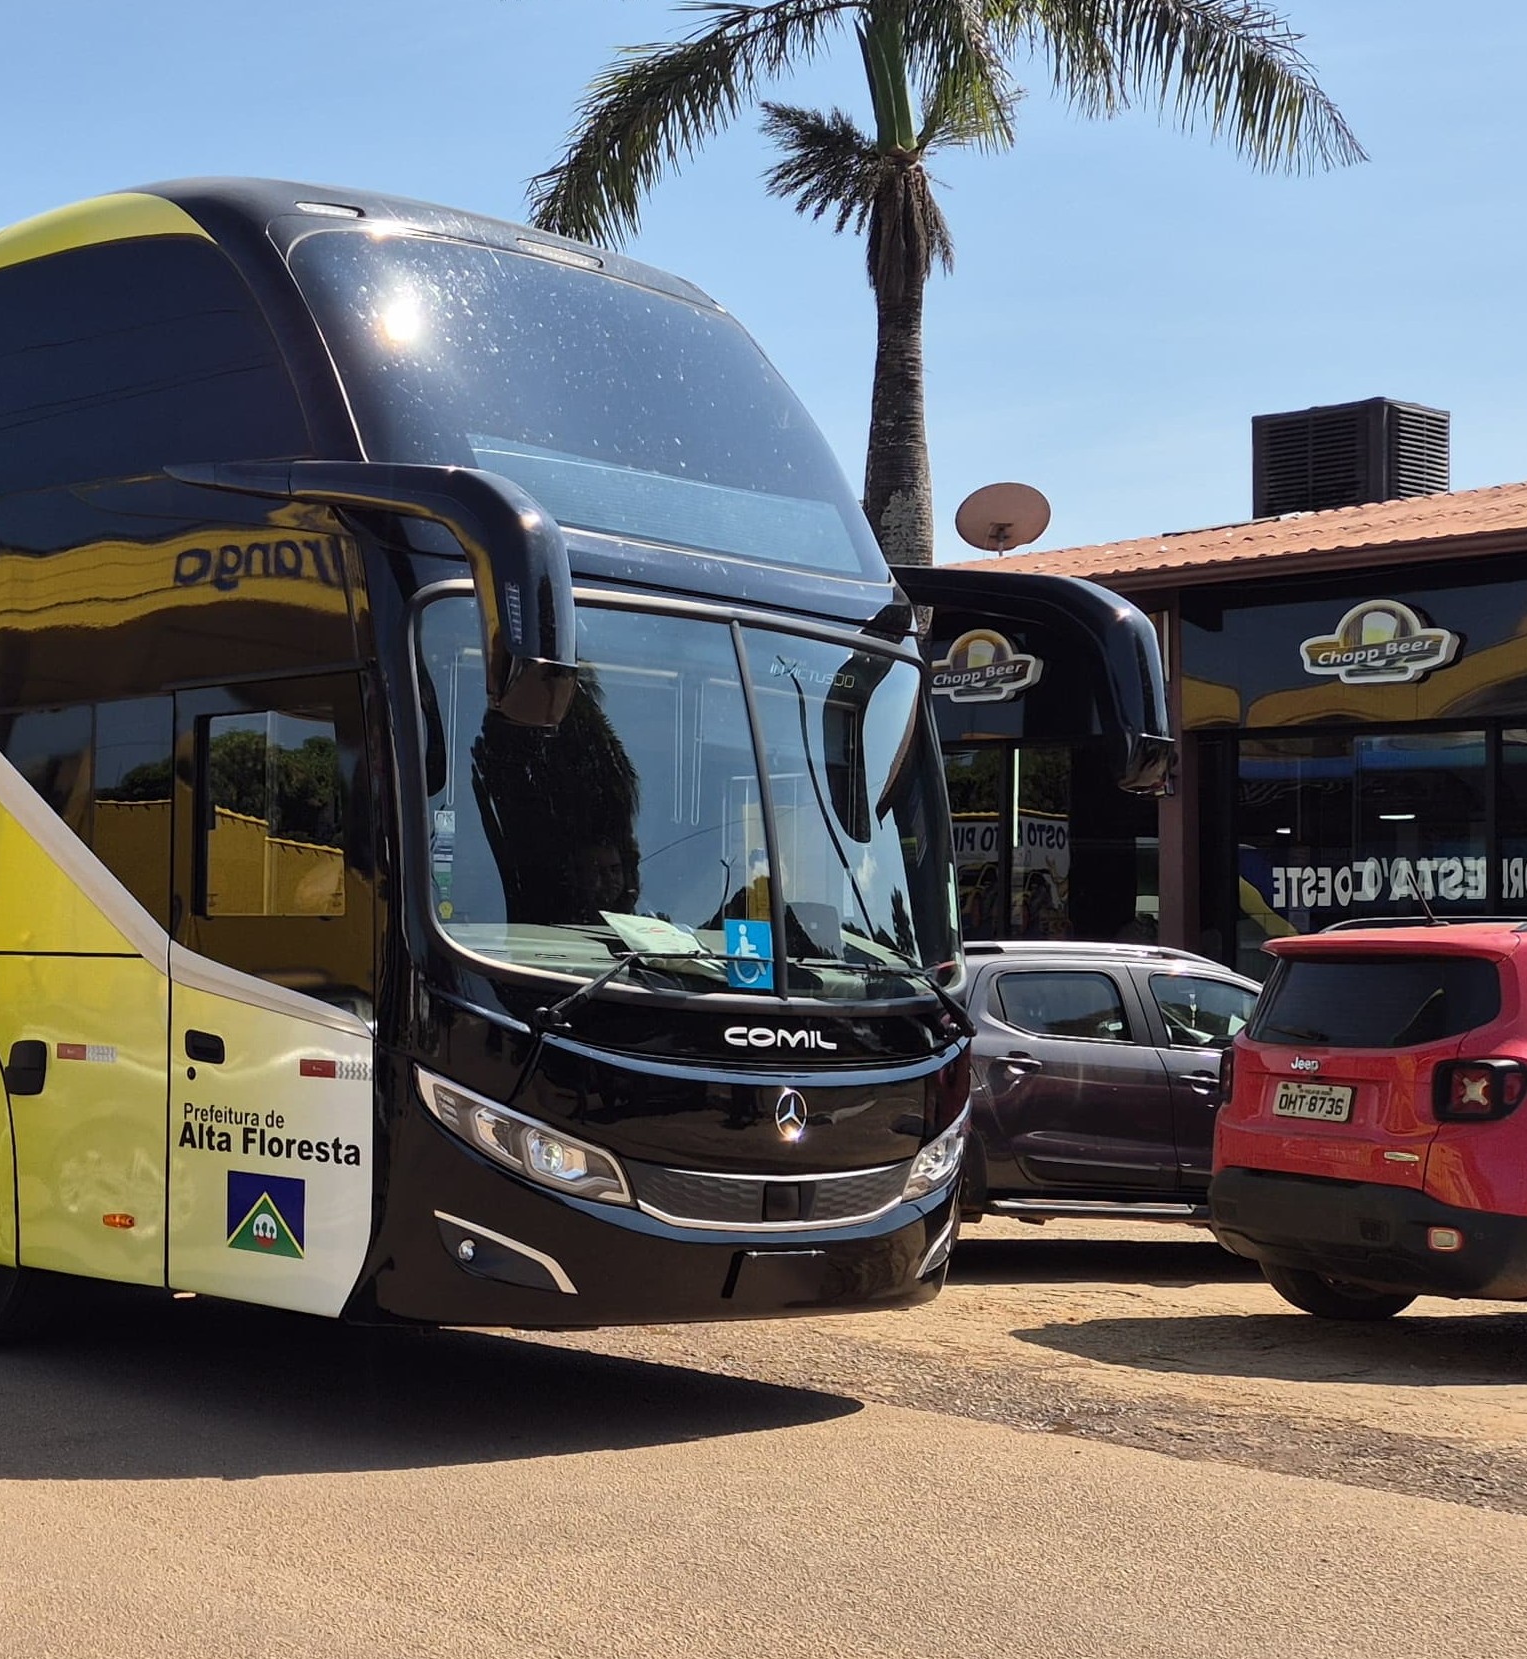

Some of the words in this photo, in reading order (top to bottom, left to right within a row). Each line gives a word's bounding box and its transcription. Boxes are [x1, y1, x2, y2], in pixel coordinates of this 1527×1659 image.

[1318, 648, 1379, 666] Chopp
[1386, 639, 1434, 656] Beer
[933, 671, 981, 685] Chopp
[985, 663, 1023, 678] Beer
[723, 1025, 838, 1050] COMIL
[1291, 1056, 1319, 1072] Jeep
[183, 1102, 260, 1127] Prefeitura
[264, 1110, 285, 1129] de
[178, 1121, 233, 1153] Alta
[242, 1128, 361, 1167] Floresta
